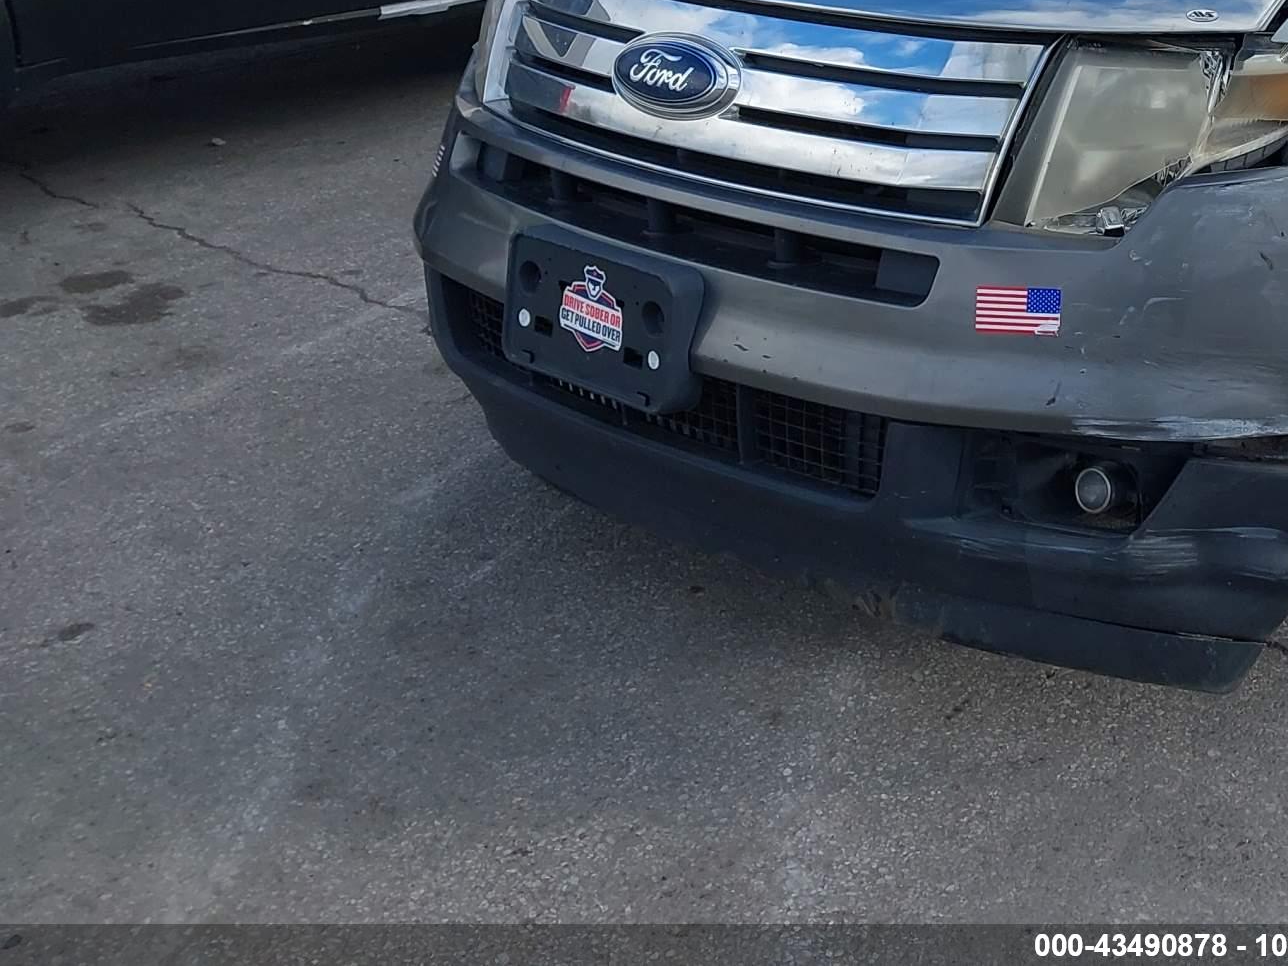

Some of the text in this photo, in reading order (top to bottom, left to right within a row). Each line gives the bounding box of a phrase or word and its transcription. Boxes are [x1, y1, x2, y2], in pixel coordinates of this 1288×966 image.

[629, 48, 695, 92] Ford
[561, 307, 621, 343] GET PULLED OVER
[564, 294, 621, 328] DRIVE SOBER OR
